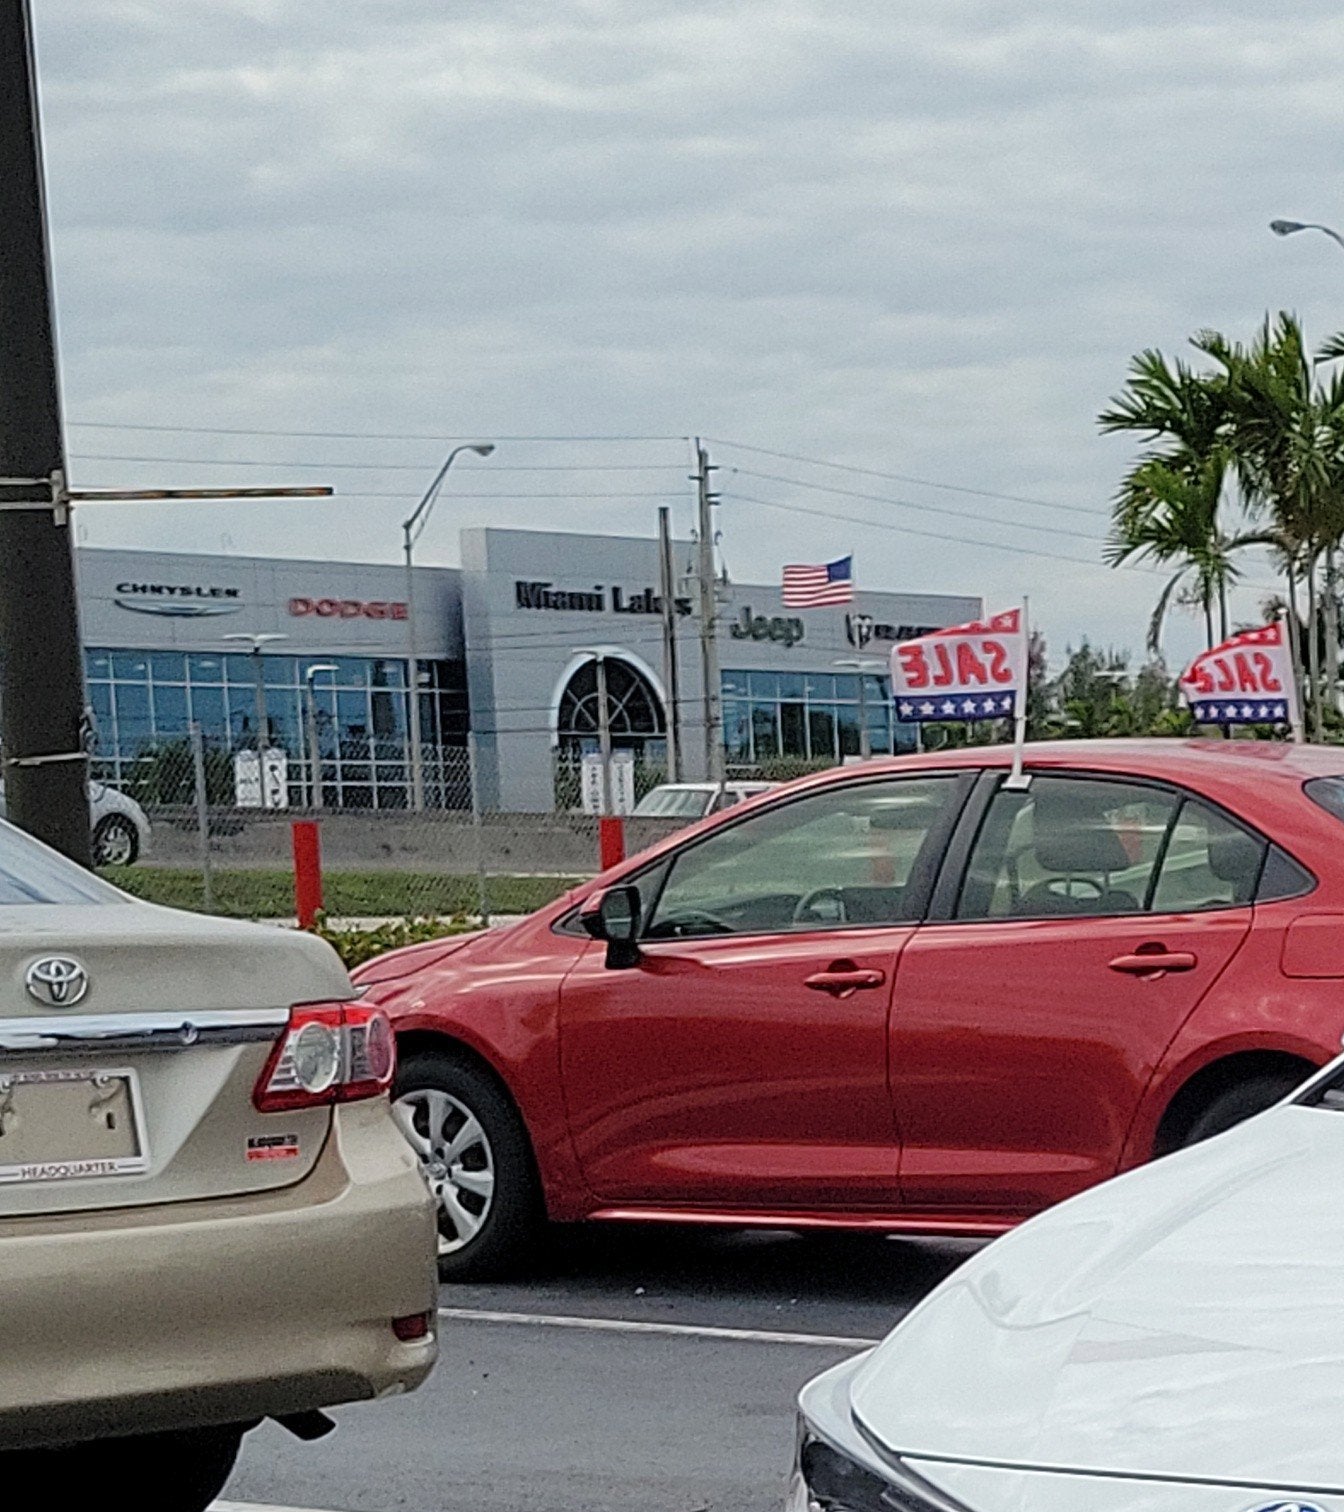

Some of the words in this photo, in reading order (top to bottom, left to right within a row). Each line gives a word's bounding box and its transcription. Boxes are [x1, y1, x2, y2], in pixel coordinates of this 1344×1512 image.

[288, 597, 409, 620] DODGE
[515, 581, 605, 612] Miami
[612, 586, 693, 615] Laks
[729, 606, 804, 648] Jeep
[21, 1161, 118, 1179] HEADQUARTER
